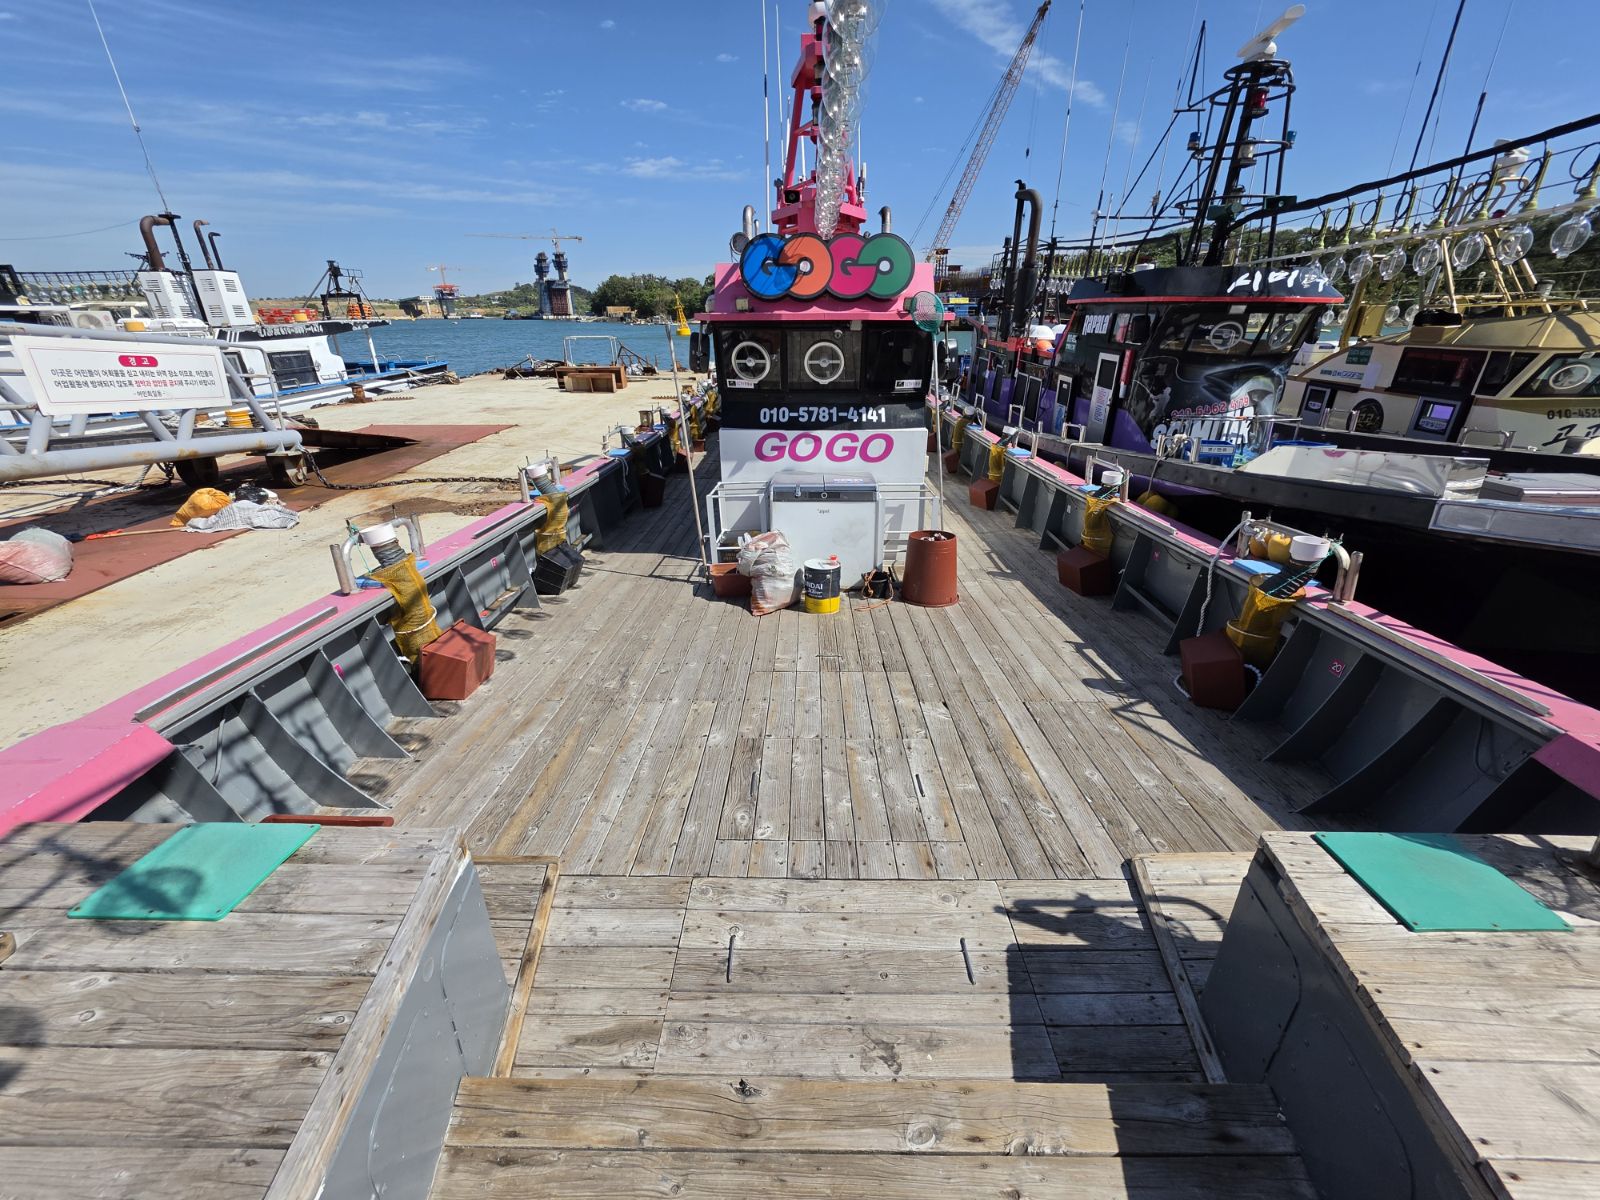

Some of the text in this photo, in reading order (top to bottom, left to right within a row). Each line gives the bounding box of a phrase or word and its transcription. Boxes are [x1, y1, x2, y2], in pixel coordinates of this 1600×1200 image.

[740, 232, 915, 299] GOGO
[50, 368, 73, 378] 이곳은
[74, 369, 101, 378] 어민들이
[90, 379, 116, 388] 방해되지
[760, 406, 886, 424] 010-5781-4141
[754, 432, 894, 463] GOGO
[1331, 661, 1342, 673] 20
